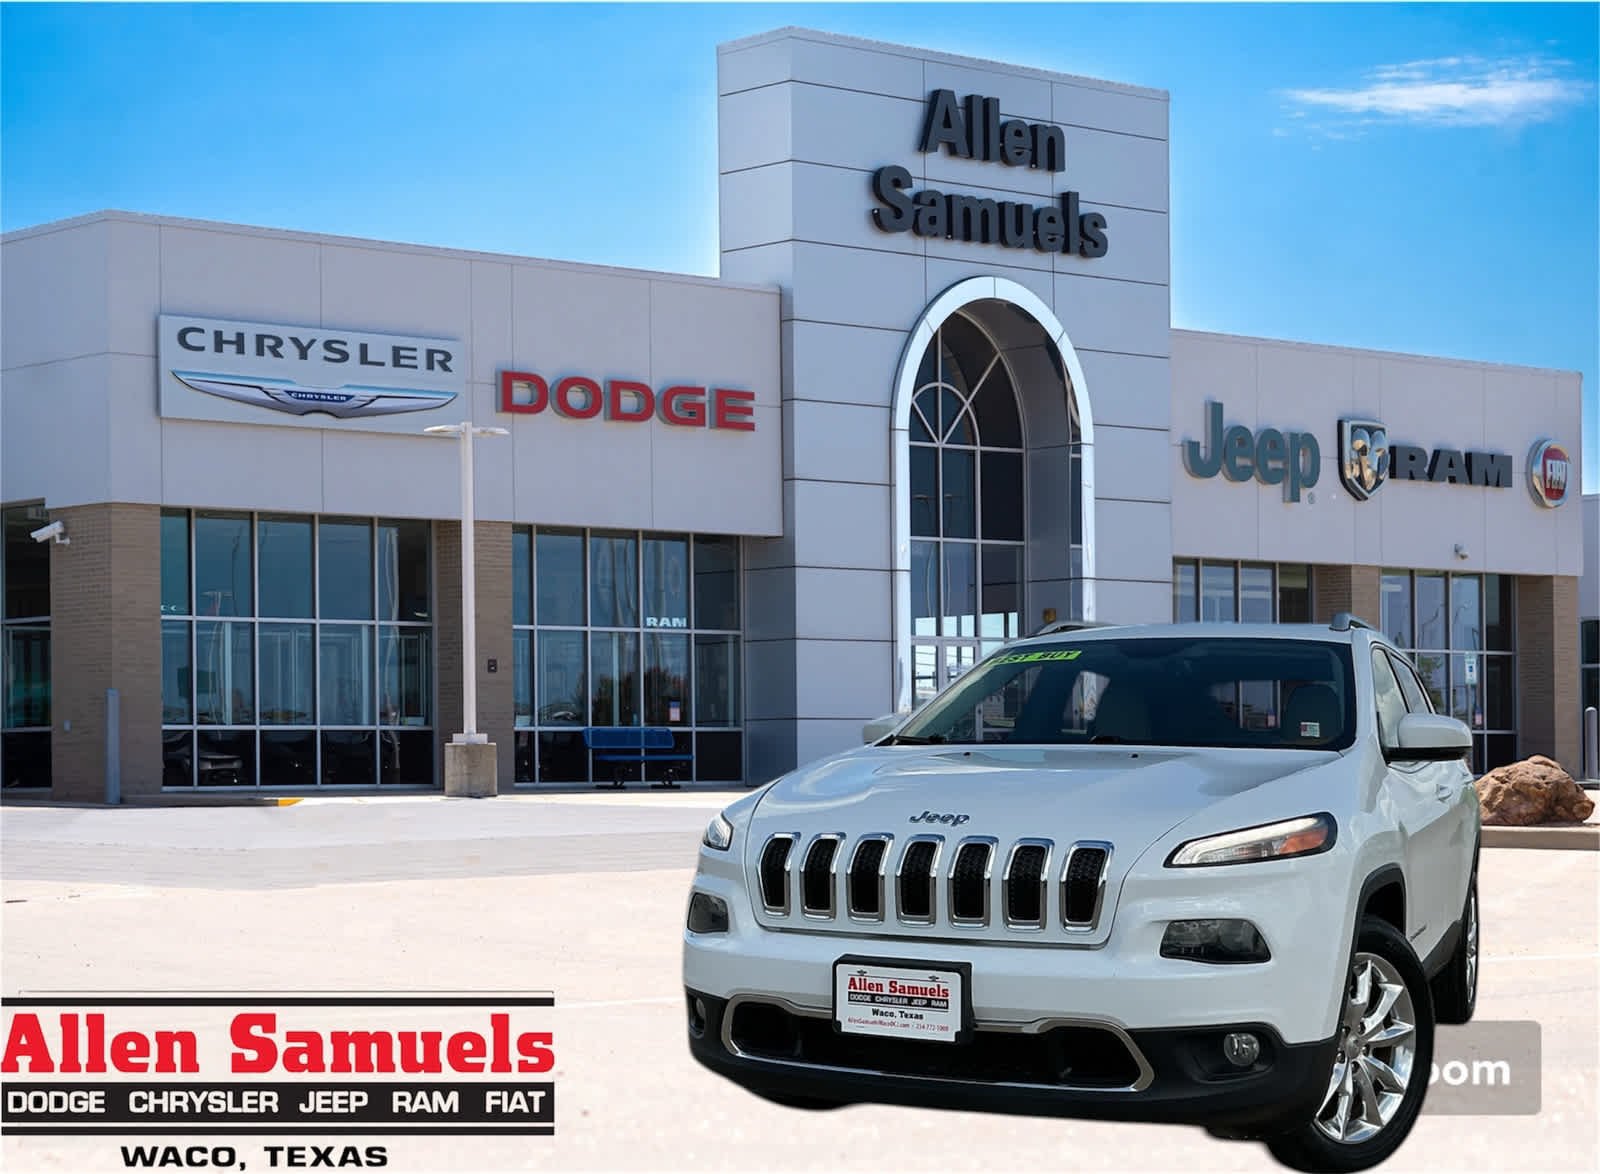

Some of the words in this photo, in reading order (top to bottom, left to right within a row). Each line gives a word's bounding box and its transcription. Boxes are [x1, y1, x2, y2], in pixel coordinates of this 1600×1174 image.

[918, 88, 1066, 173] Allen
[871, 165, 1108, 258] Samuels
[177, 326, 454, 373] CHRYSLER
[290, 392, 347, 401] CHRYSLER
[496, 370, 755, 432] DODGE
[1182, 400, 1321, 503] Jeep
[1388, 445, 1513, 488] RAM
[646, 616, 688, 628] RAM
[909, 810, 970, 827] Jeep
[848, 977, 884, 993] Allen
[888, 980, 949, 998] Samuels
[850, 993, 872, 1002] DODGE
[875, 995, 908, 1005] CHRYSLER
[911, 998, 928, 1007] JEEP
[931, 1000, 947, 1008] RAM
[871, 1008, 897, 1019] Waco,
[899, 1010, 924, 1020] Texas
